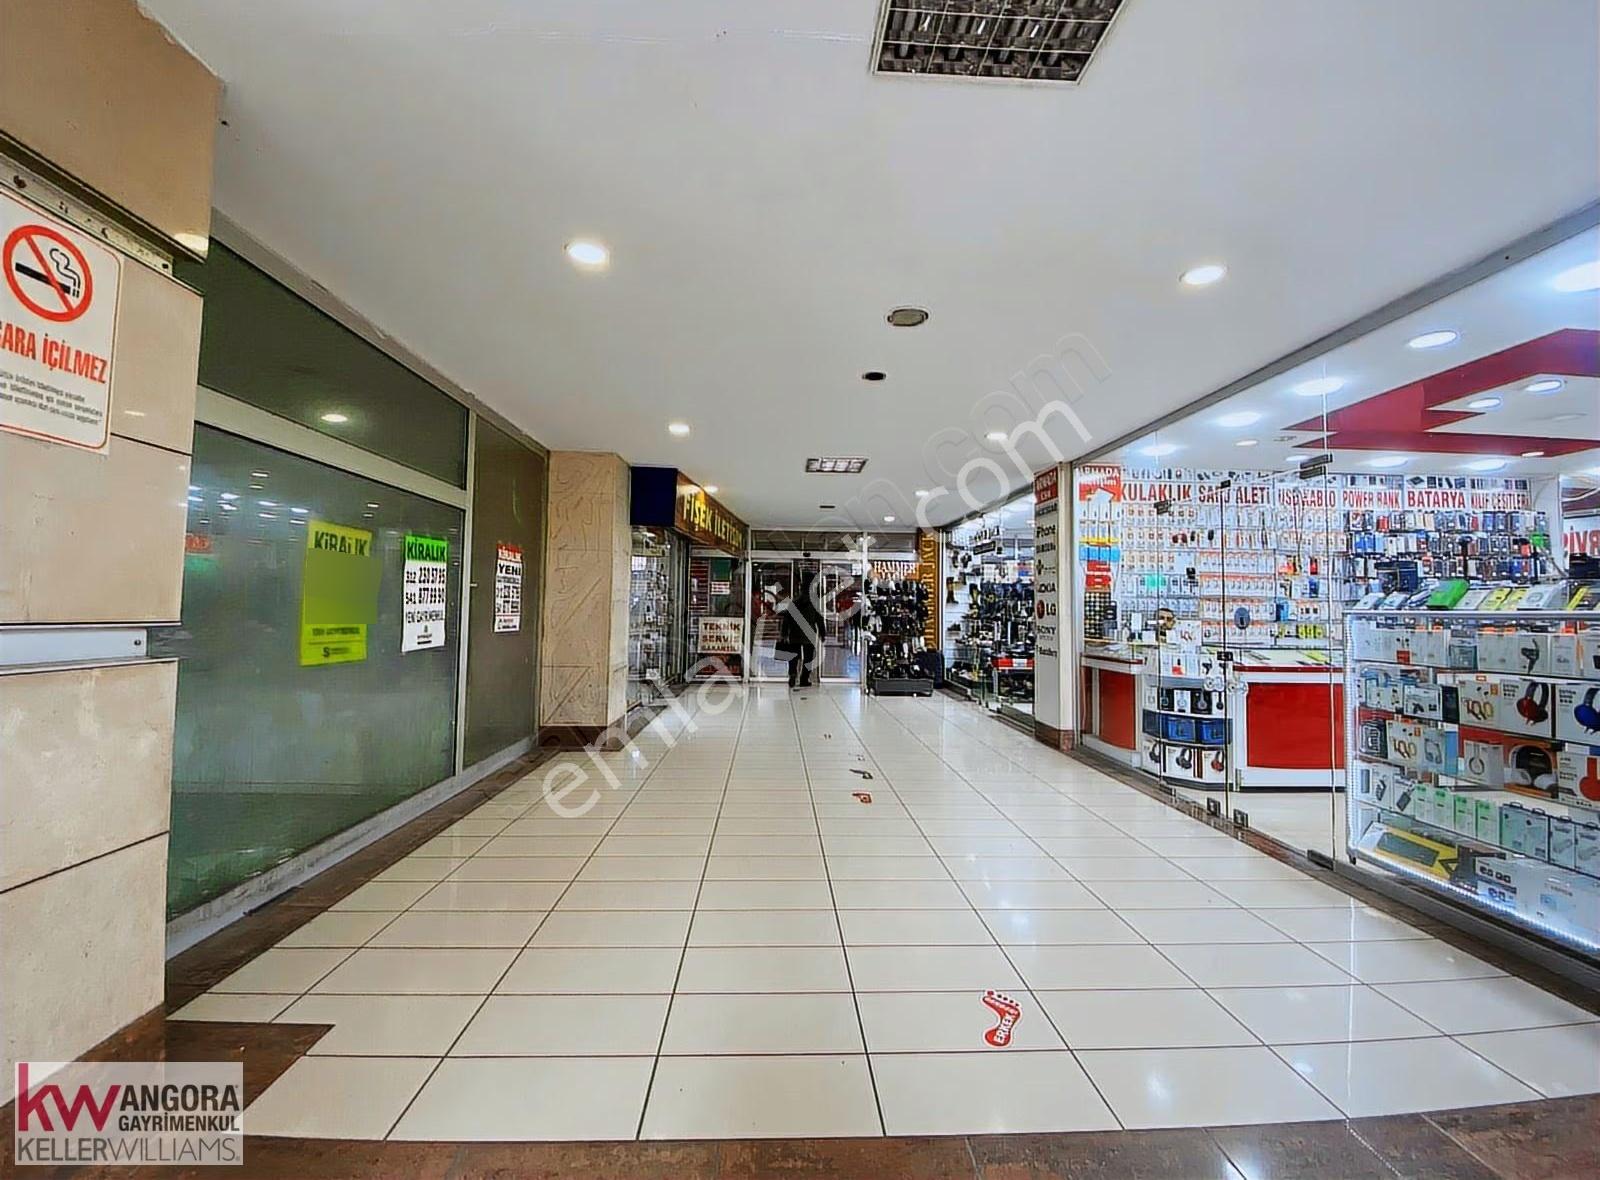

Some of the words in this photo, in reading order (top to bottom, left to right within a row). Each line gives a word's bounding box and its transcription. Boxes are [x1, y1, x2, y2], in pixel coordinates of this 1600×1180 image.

[0, 321, 36, 360] ARA
[42, 332, 107, 384] İÇİLMEZ
[1120, 482, 1191, 501] KULAKLIK
[1407, 490, 1466, 509] BATARYA
[407, 538, 446, 562] KİRALIK
[1046, 603, 1056, 616] LG
